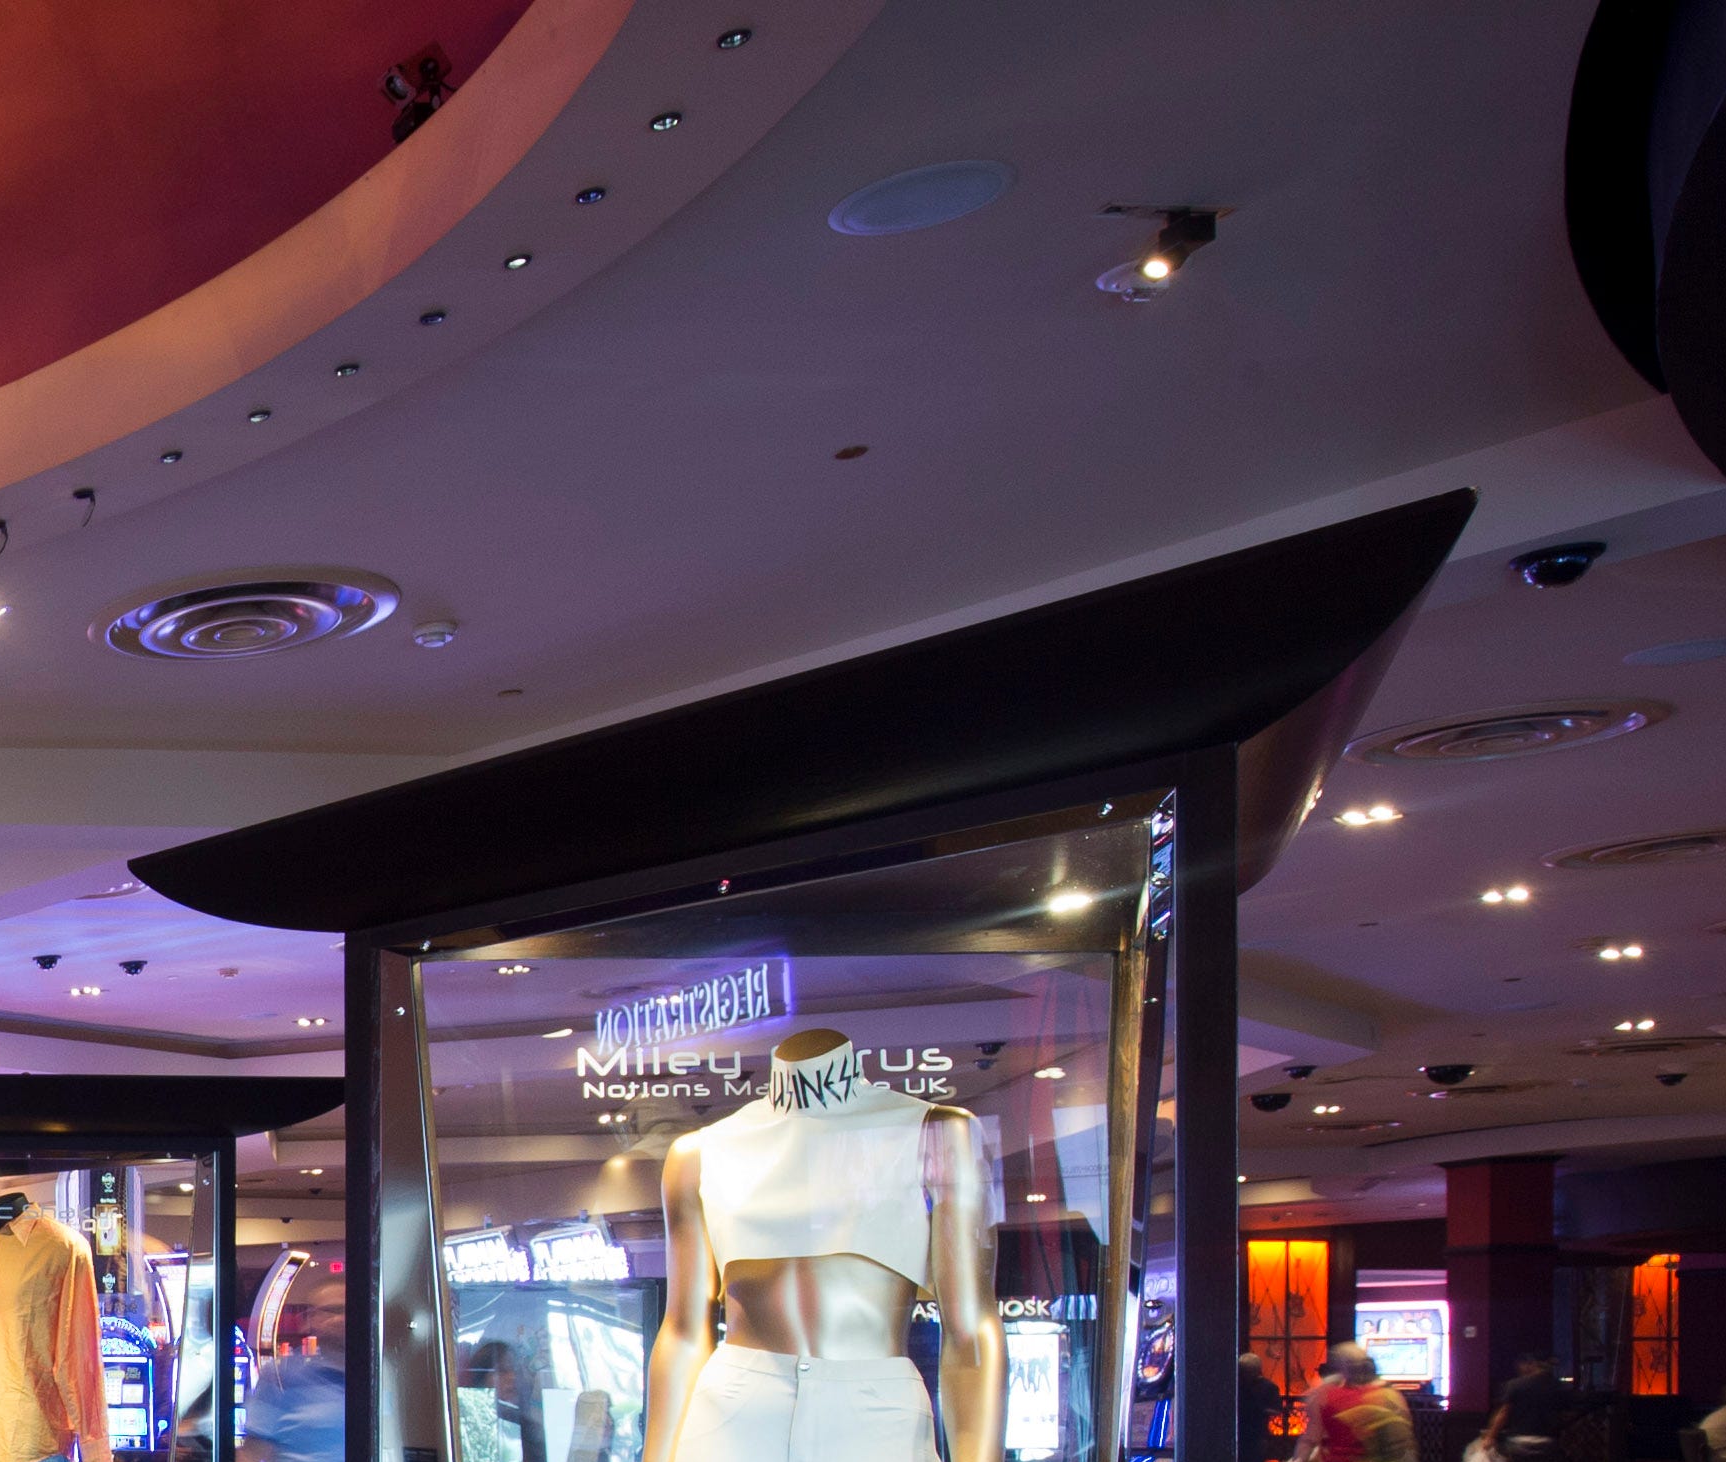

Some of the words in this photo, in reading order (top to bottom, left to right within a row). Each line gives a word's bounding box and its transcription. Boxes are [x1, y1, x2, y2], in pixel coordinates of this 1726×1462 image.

[576, 1045, 742, 1081] Miley
[771, 1046, 954, 1073] rus
[904, 1076, 948, 1095] UK
[998, 1299, 1051, 1318] IOSK
